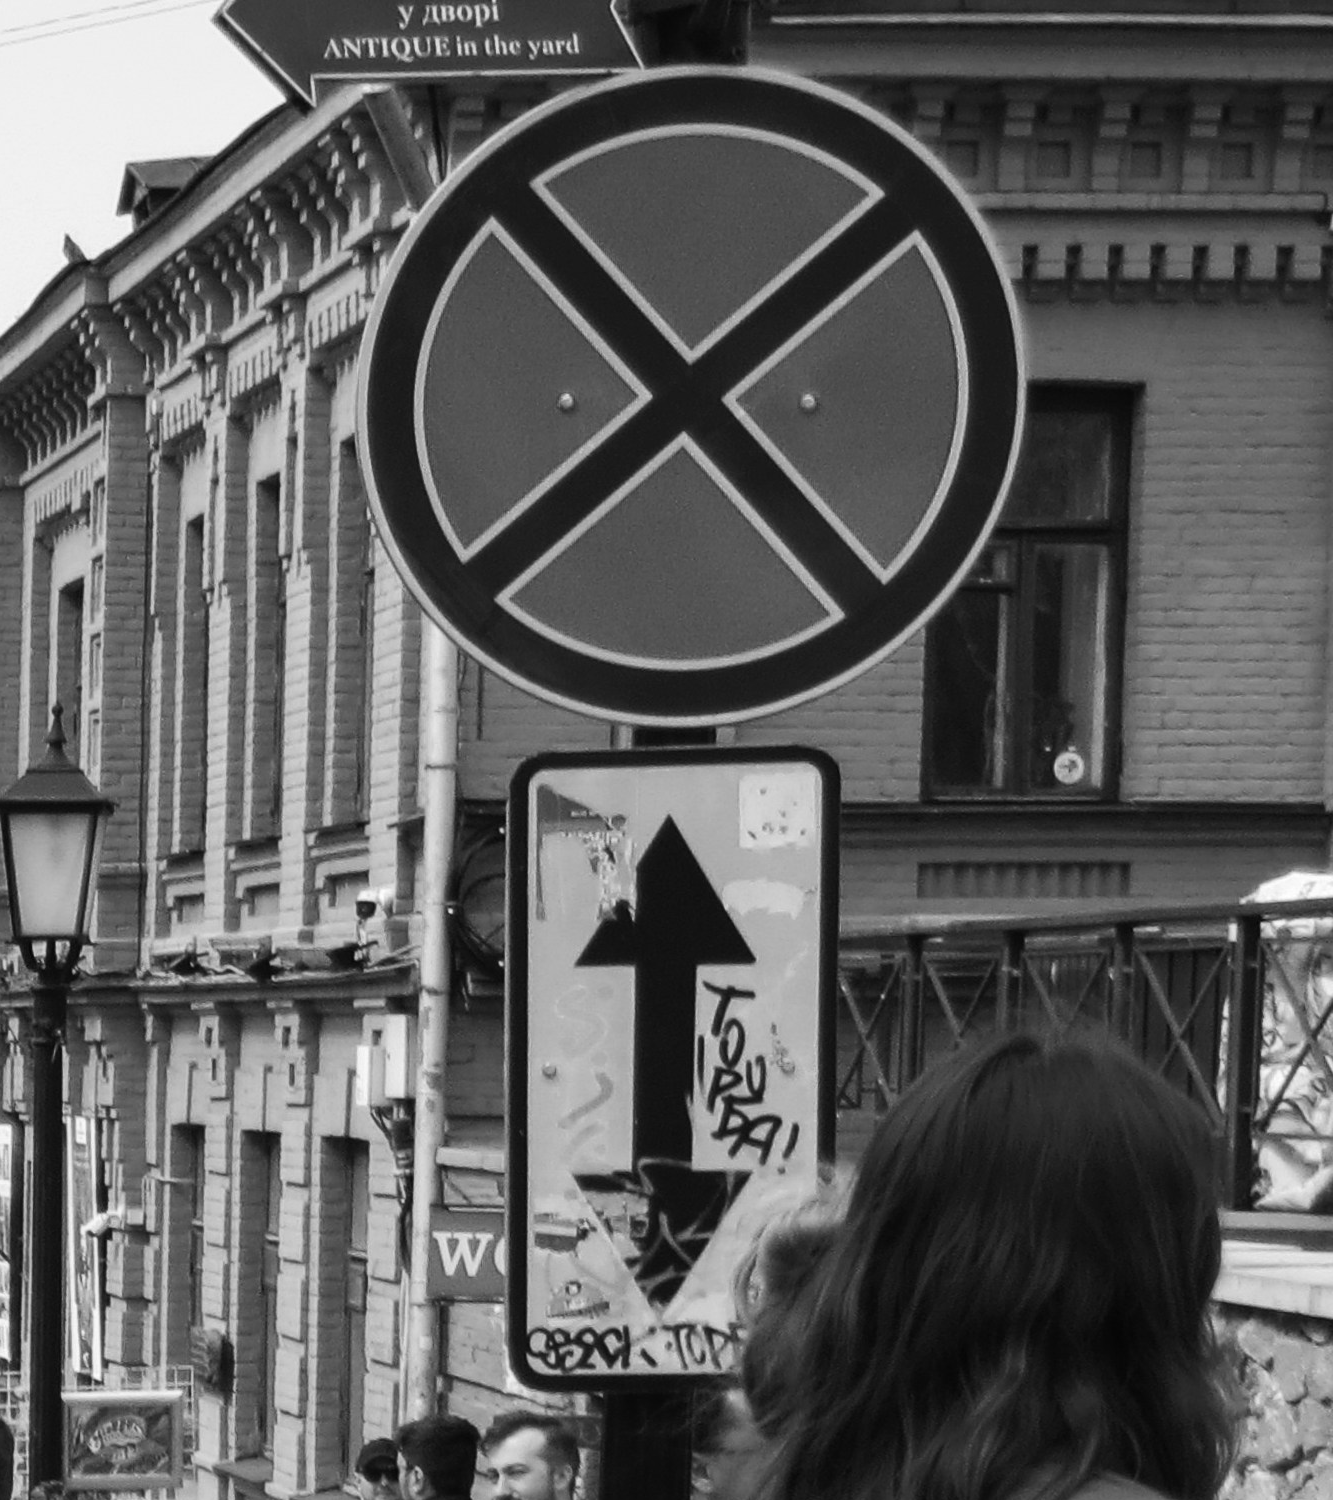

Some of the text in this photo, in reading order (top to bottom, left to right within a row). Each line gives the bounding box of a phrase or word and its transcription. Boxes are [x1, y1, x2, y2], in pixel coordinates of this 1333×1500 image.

[422, 0, 500, 28] дворі
[323, 32, 580, 62] ANTIQUE in the yard
[431, 1230, 507, 1278] W
